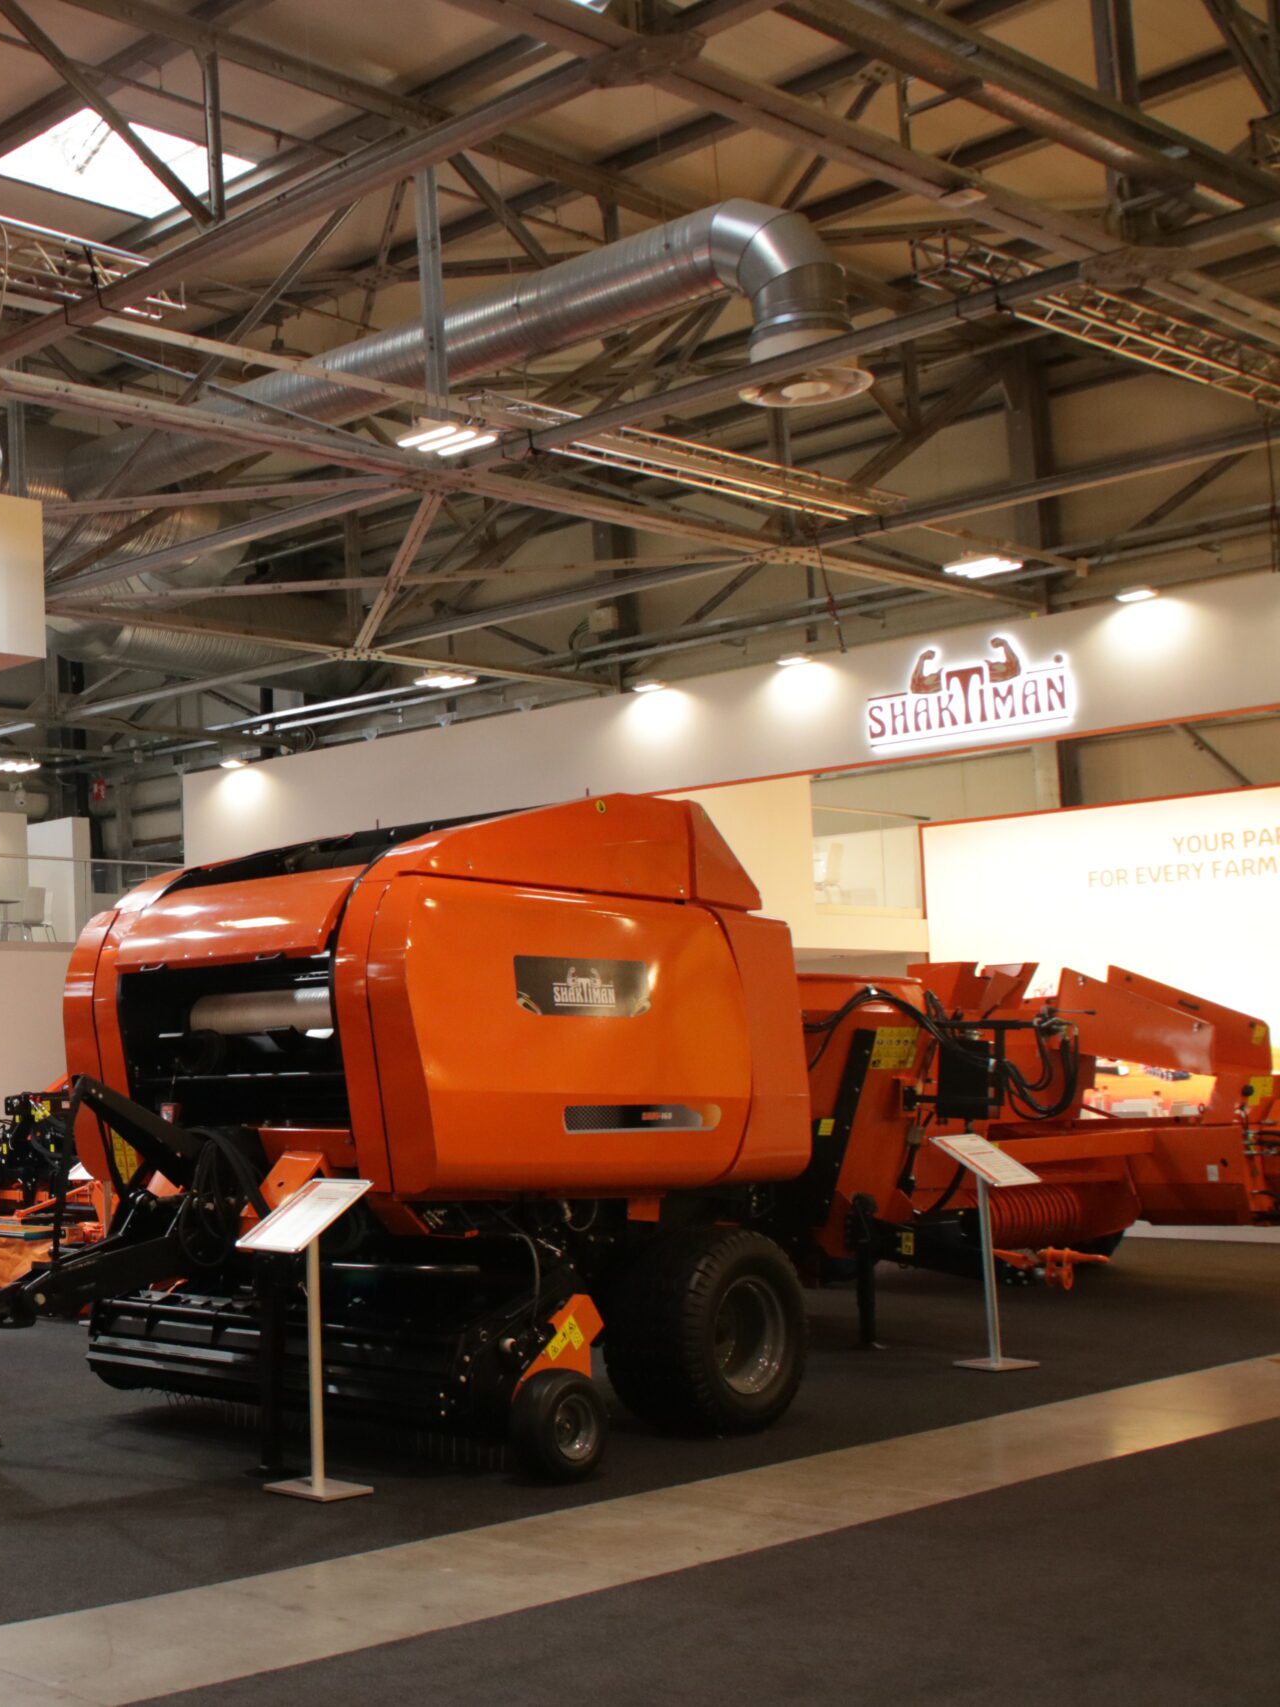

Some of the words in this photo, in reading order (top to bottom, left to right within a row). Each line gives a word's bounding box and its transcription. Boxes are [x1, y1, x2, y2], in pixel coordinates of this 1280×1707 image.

[868, 666, 1066, 739] SHAKTIMAN
[1172, 832, 1235, 853] YOUR
[1087, 868, 1129, 888] FOR
[1135, 862, 1204, 885] EVERY
[553, 977, 616, 1004] SHAKTIMAN
